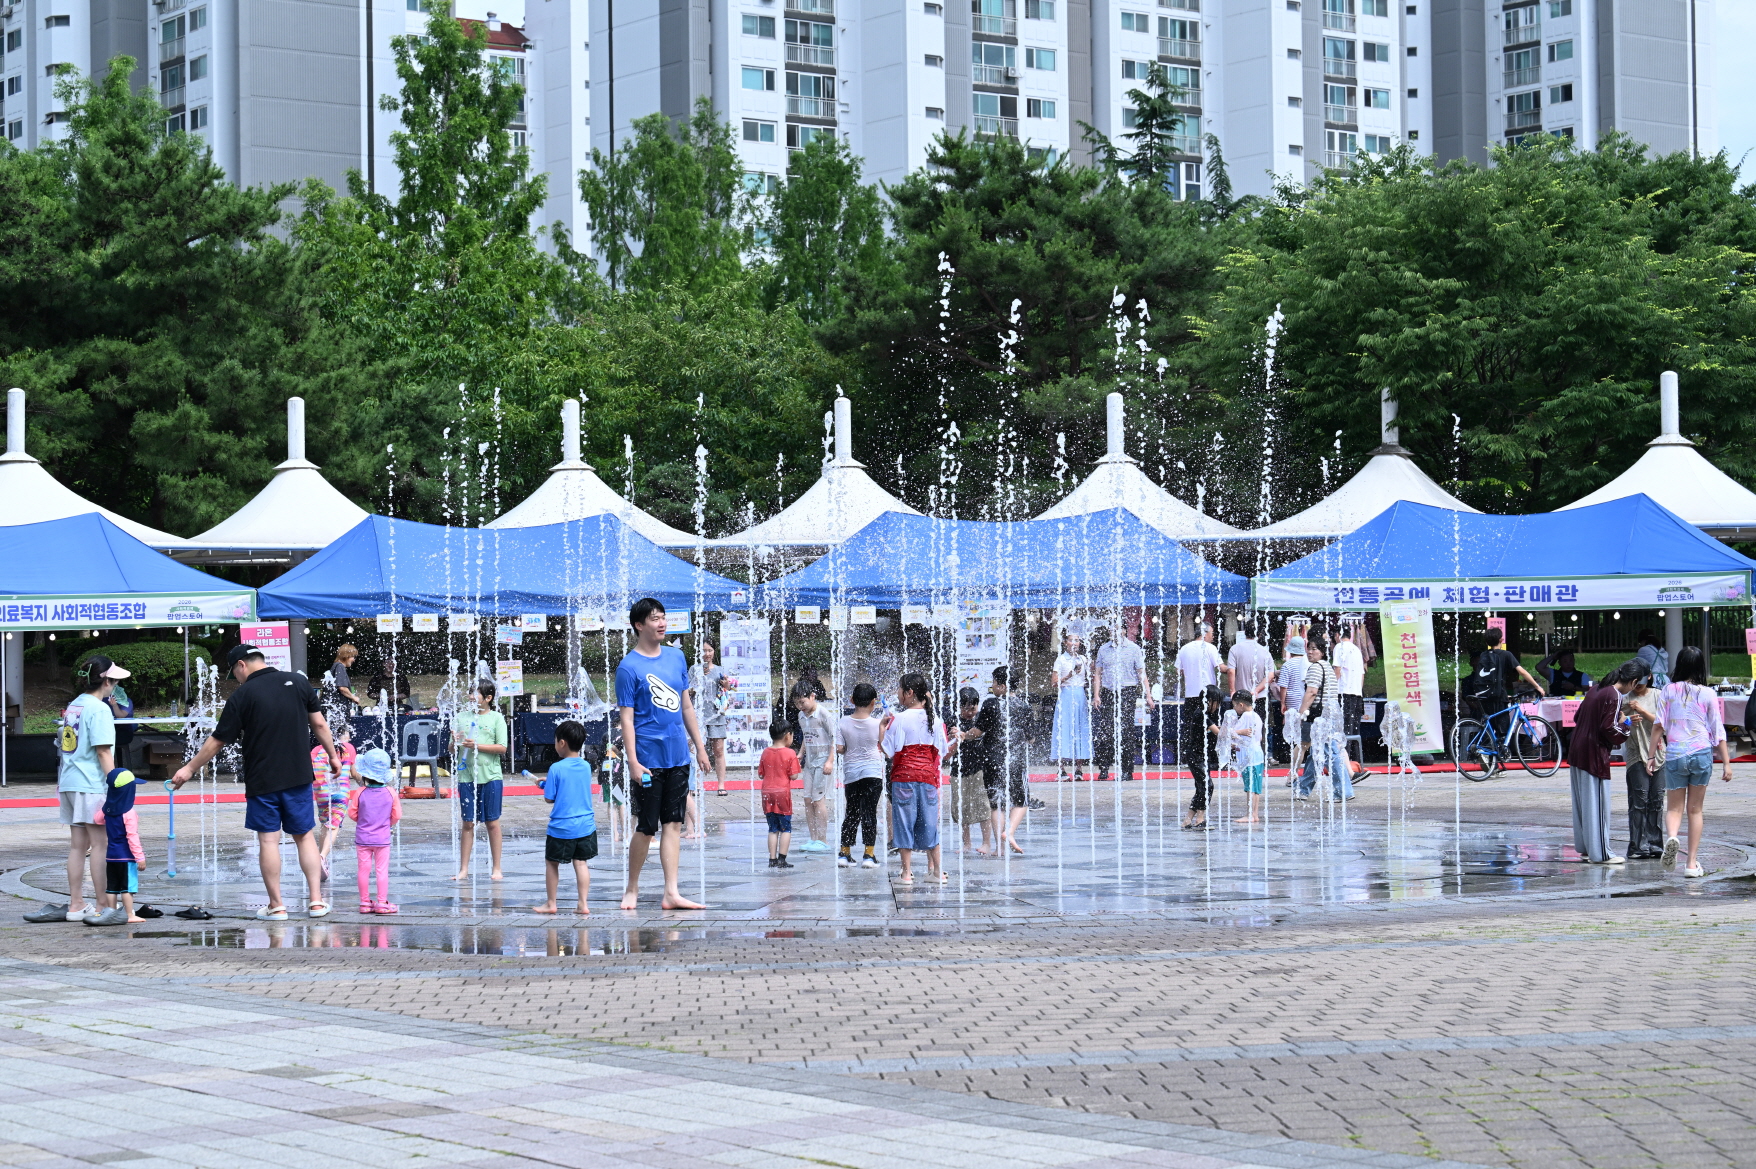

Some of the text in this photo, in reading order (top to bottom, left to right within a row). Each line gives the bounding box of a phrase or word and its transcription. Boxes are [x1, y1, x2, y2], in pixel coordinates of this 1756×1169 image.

[1333, 586, 1430, 604] 전통공예
[1656, 593, 1695, 602] 팝업스토어
[51, 602, 147, 622] 사회적협동조합
[167, 612, 203, 621] 팝업스토어
[1400, 632, 1422, 707] 천연염색
